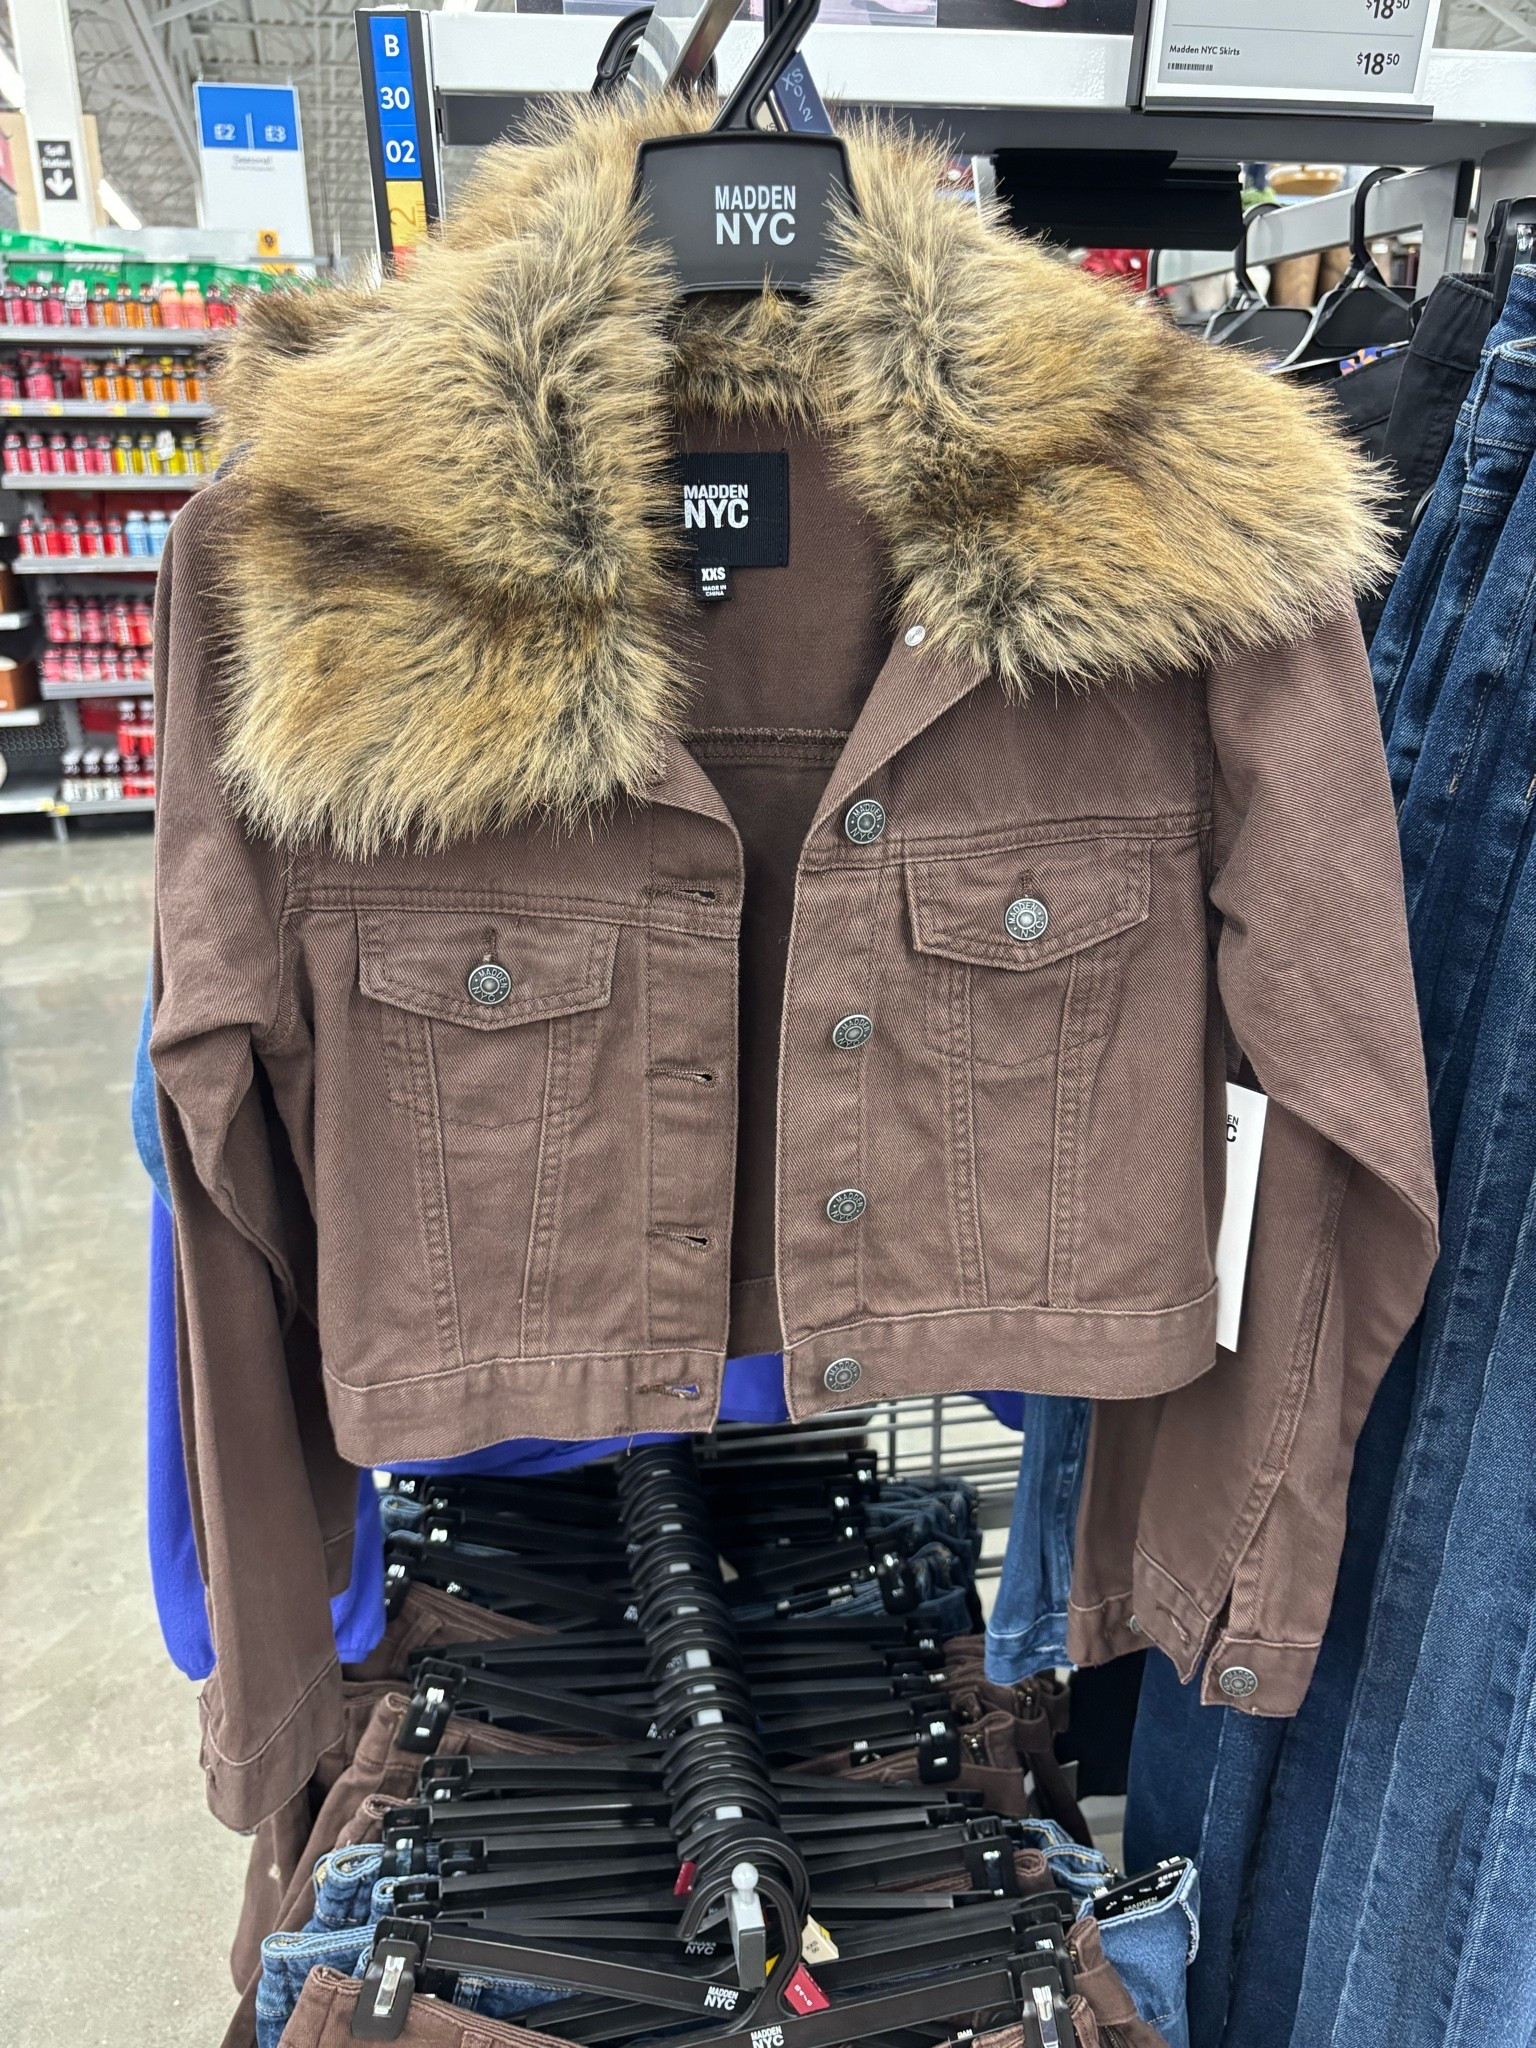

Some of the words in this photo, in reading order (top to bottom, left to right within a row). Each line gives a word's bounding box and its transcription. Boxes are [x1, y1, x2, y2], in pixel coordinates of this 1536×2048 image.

[384, 34, 400, 57] B
[1169, 45, 1199, 54] Madden
[1200, 46, 1218, 55] NYC
[1219, 46, 1240, 56] Skirts
[782, 68, 804, 91] XS
[380, 87, 410, 109] 30
[214, 123, 236, 141] E2
[265, 125, 286, 142] E3
[386, 140, 416, 163] 02
[715, 185, 796, 210] MADDEN
[716, 212, 796, 246] NYC
[684, 484, 748, 499] MADDEN
[684, 499, 749, 529] NYC
[701, 567, 726, 581] XXS
[853, 803, 882, 822] MADDEN
[1008, 901, 1037, 924] MADDEN
[479, 968, 507, 989] MADDEN
[684, 1944, 716, 1956] NYC
[708, 1986, 738, 2001] MADDEN
[704, 1995, 736, 2011] NYC
[751, 2025, 782, 2041] MADDEN
[752, 2035, 784, 2048] NYC
